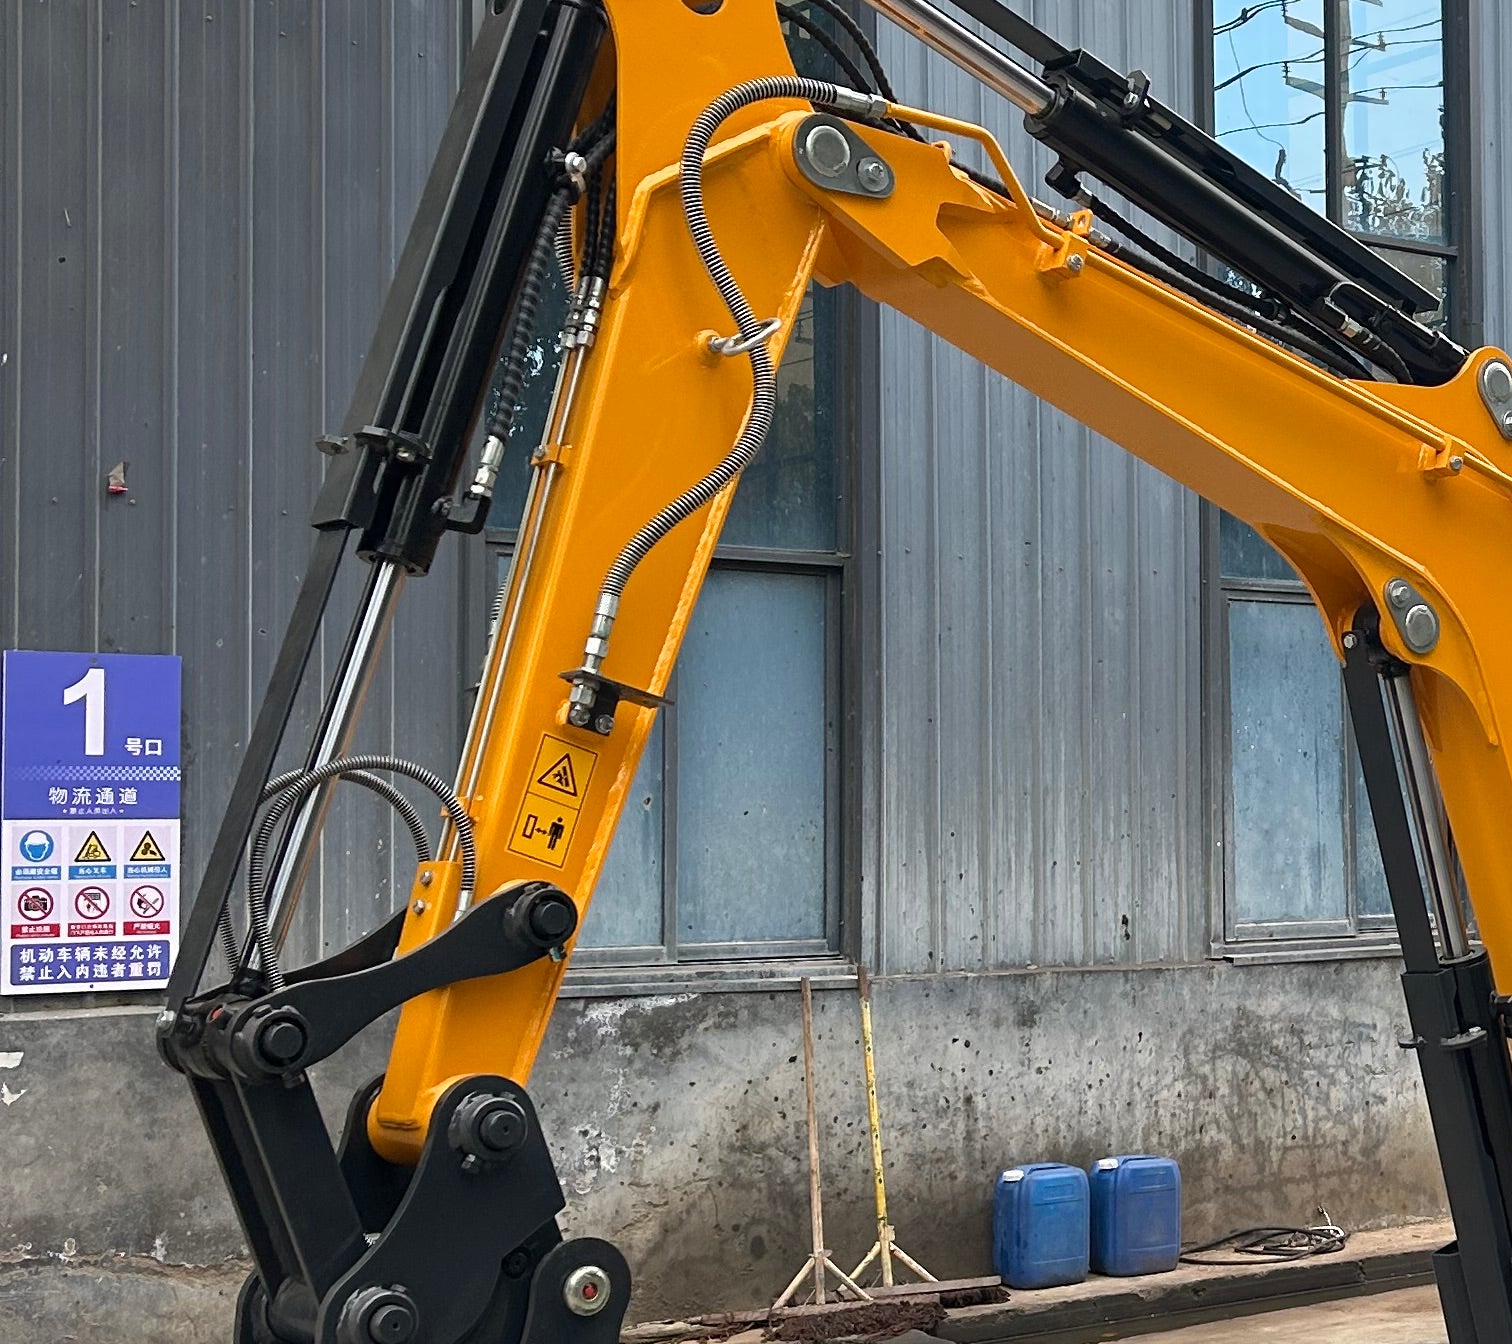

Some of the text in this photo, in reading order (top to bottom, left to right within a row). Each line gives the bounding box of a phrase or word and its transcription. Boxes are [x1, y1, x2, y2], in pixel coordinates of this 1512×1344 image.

[63, 668, 162, 756] 1 号口
[48, 786, 138, 805] 物流通道
[19, 944, 162, 963] 机动车辆未经允许
[19, 961, 162, 982] 禁止入内违者重罚
